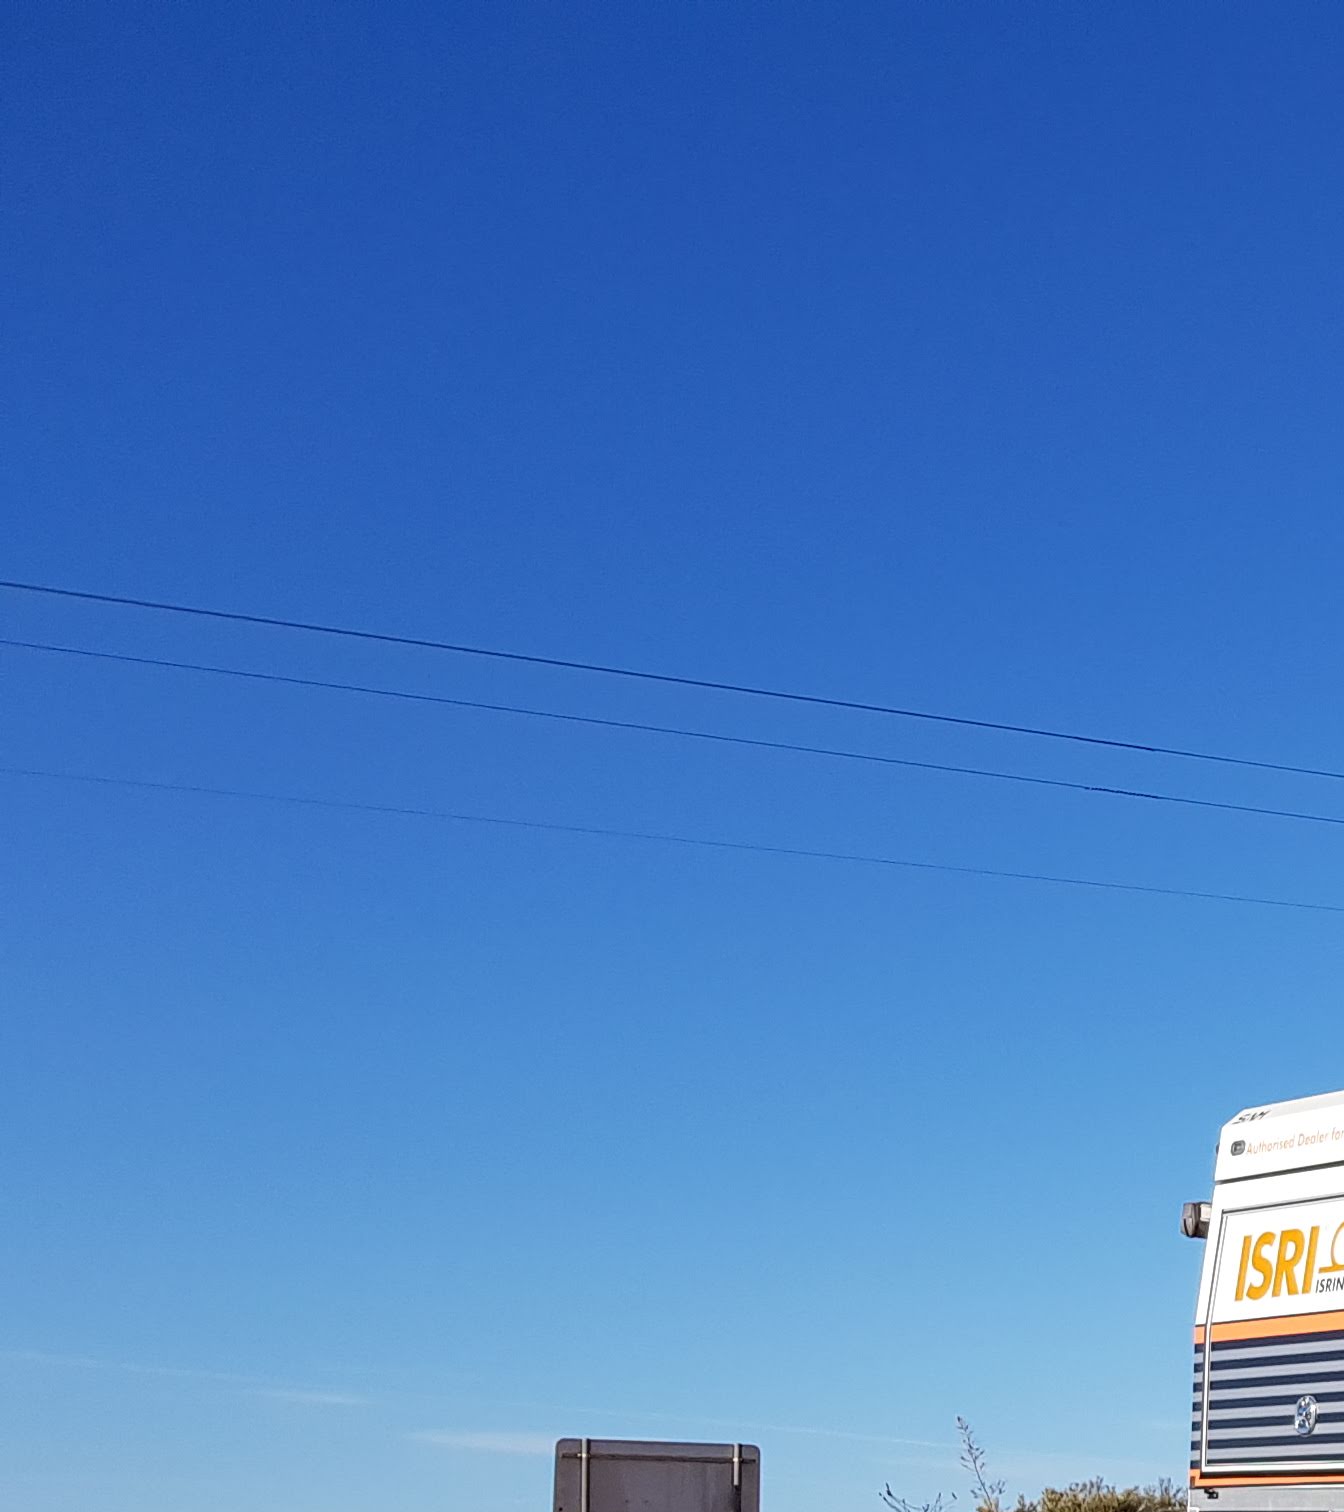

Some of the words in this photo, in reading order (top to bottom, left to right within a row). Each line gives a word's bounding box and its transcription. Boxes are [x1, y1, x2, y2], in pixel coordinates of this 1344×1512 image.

[1246, 1134, 1295, 1154] Authorised
[1297, 1130, 1328, 1146] Dealer
[1331, 1127, 1344, 1140] for
[1234, 1226, 1320, 1301] ISRI
